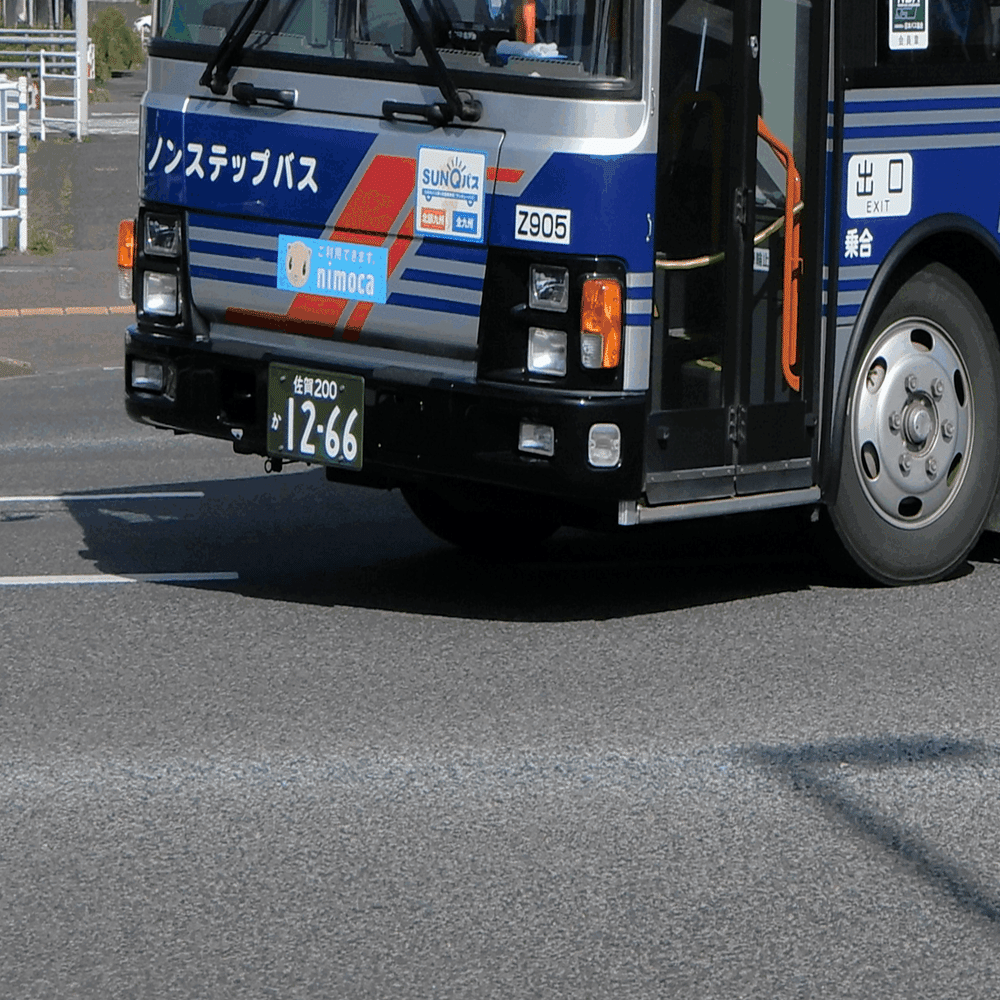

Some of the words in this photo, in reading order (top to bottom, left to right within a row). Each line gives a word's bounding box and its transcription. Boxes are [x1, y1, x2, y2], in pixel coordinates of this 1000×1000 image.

[148, 136, 319, 193] ノンステップバス
[422, 168, 479, 190] SUNQパス
[856, 158, 904, 197] 出口
[866, 200, 890, 213] EXIT
[517, 208, 568, 240] Z905
[844, 227, 873, 259] 乗合
[317, 260, 375, 297] nimoca
[271, 412, 282, 431] か
[287, 396, 359, 461] 12-66
